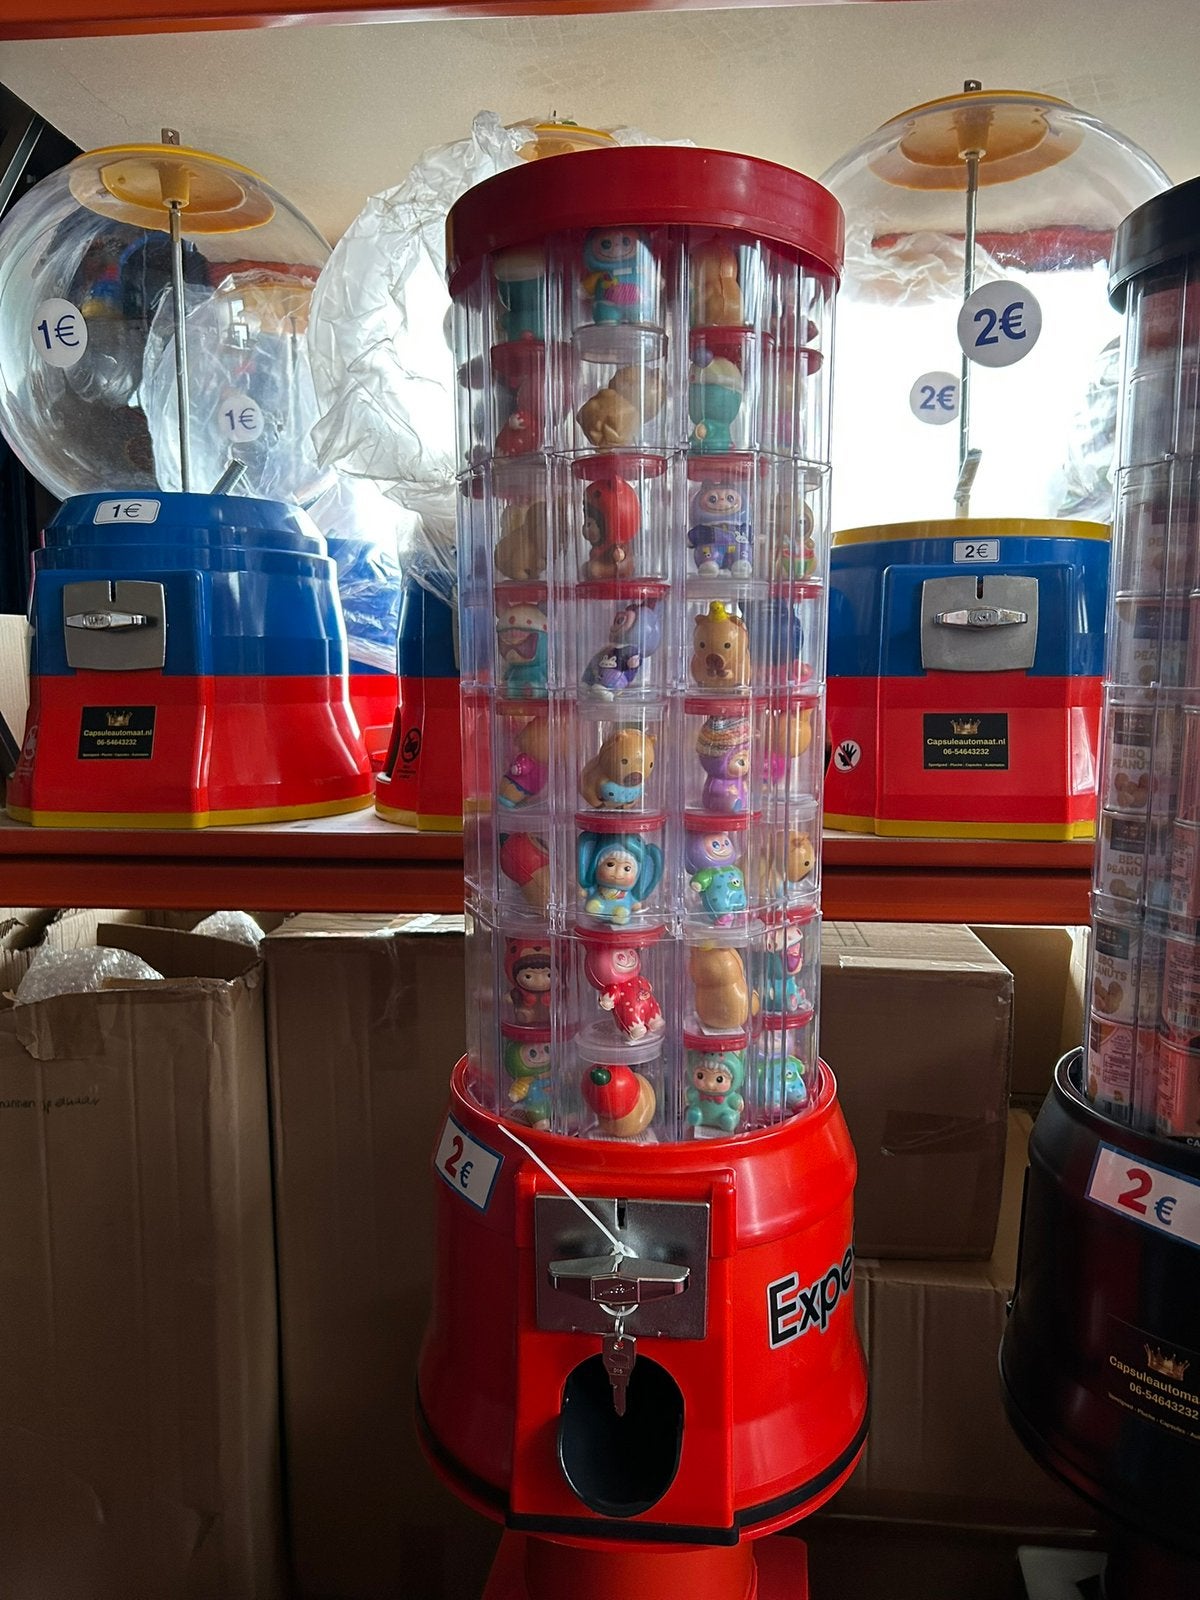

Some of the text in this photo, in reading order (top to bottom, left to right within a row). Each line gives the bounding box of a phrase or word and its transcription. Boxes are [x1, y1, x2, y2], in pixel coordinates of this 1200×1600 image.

[37, 314, 80, 350] 1€
[973, 301, 1027, 347] 2€
[919, 385, 956, 411] 2€
[224, 407, 257, 431] 1€
[112, 502, 142, 519] 1€
[964, 543, 990, 558] 2€
[83, 729, 152, 737] Capsuleautomaat.nl
[927, 738, 1006, 746] Capsuleautomaat.nl
[768, 1244, 856, 1347] Expe
[1109, 1355, 1200, 1405] Capsuleautoma
[1129, 1382, 1200, 1421] 06-54643232
